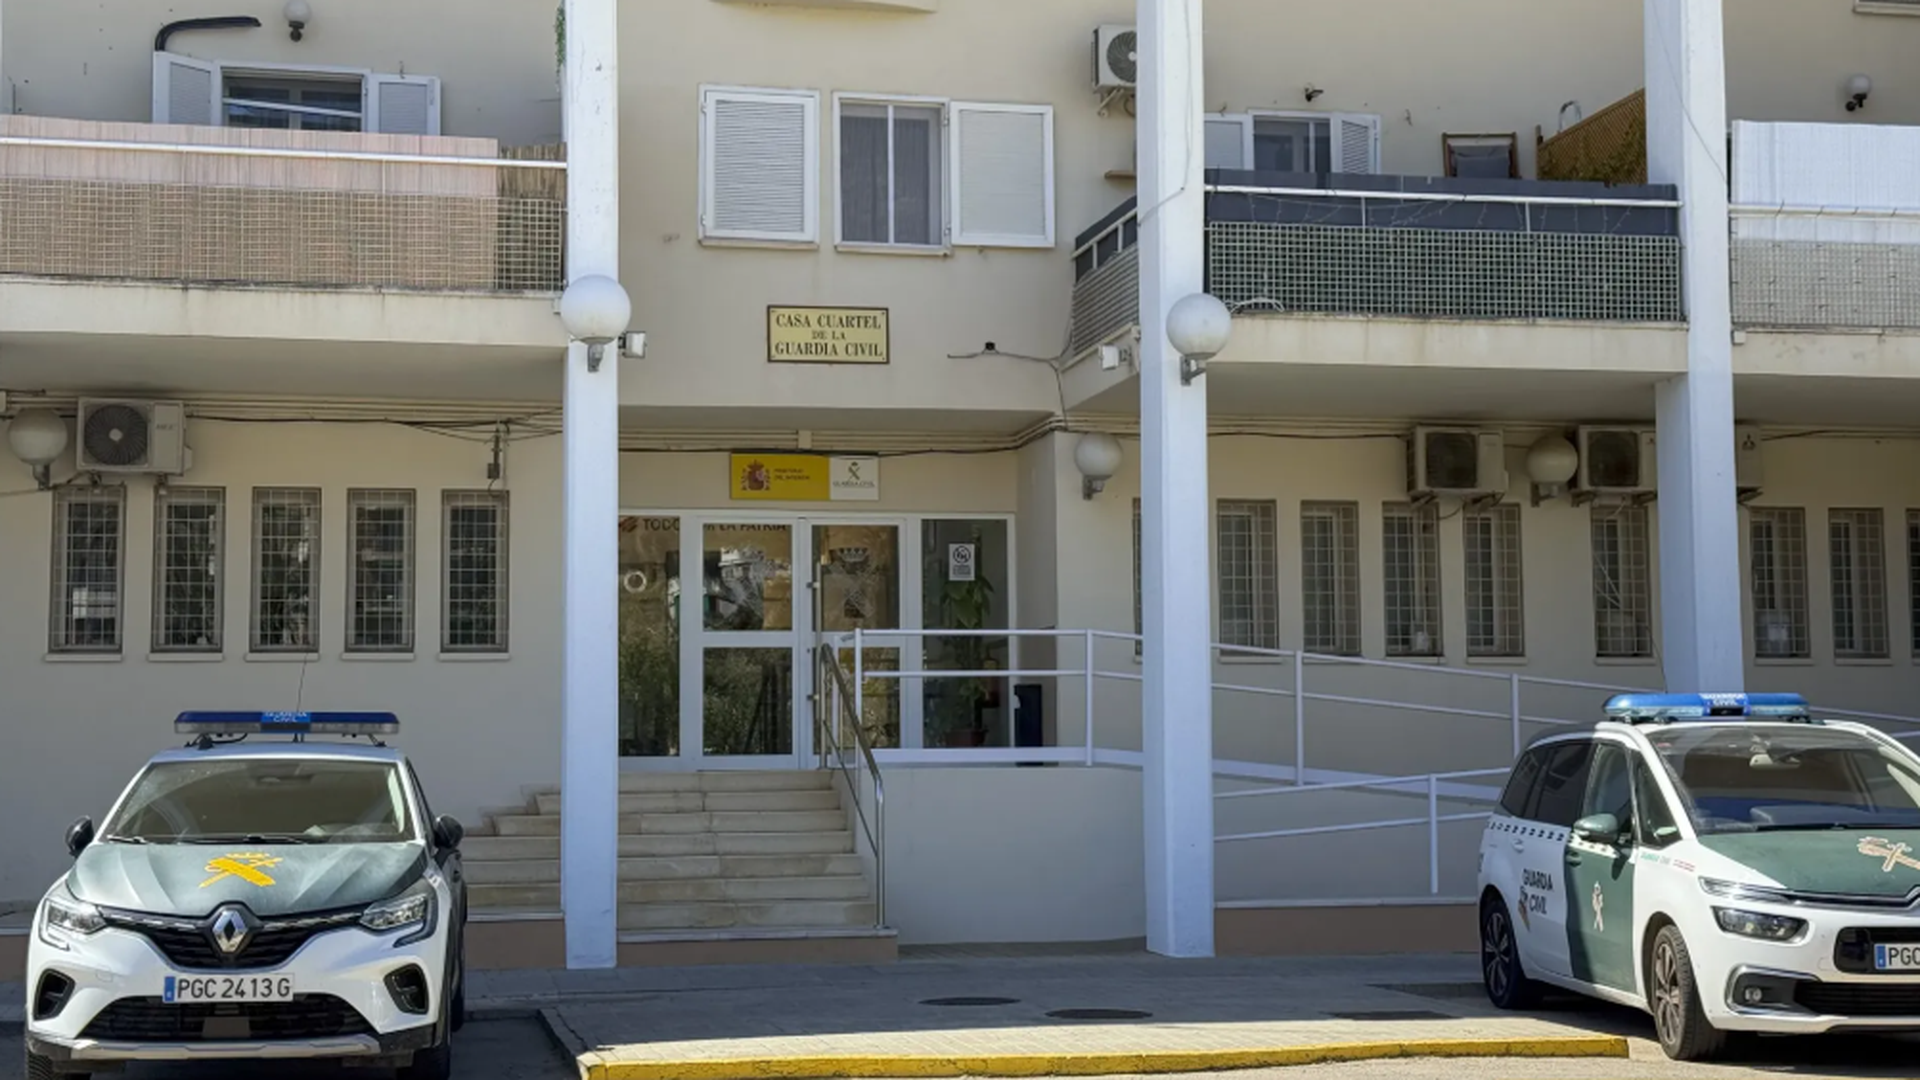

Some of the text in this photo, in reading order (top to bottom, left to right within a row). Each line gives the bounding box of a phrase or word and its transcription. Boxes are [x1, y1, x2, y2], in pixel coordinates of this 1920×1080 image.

[776, 313, 881, 329] CASA CUARTEL
[811, 330, 846, 340] DE LA
[774, 342, 883, 357] GUARDIA CIVIL
[1522, 868, 1554, 892] GUARDIA
[1529, 893, 1548, 915] CIVIL
[177, 977, 290, 999] PGC 2413 G
